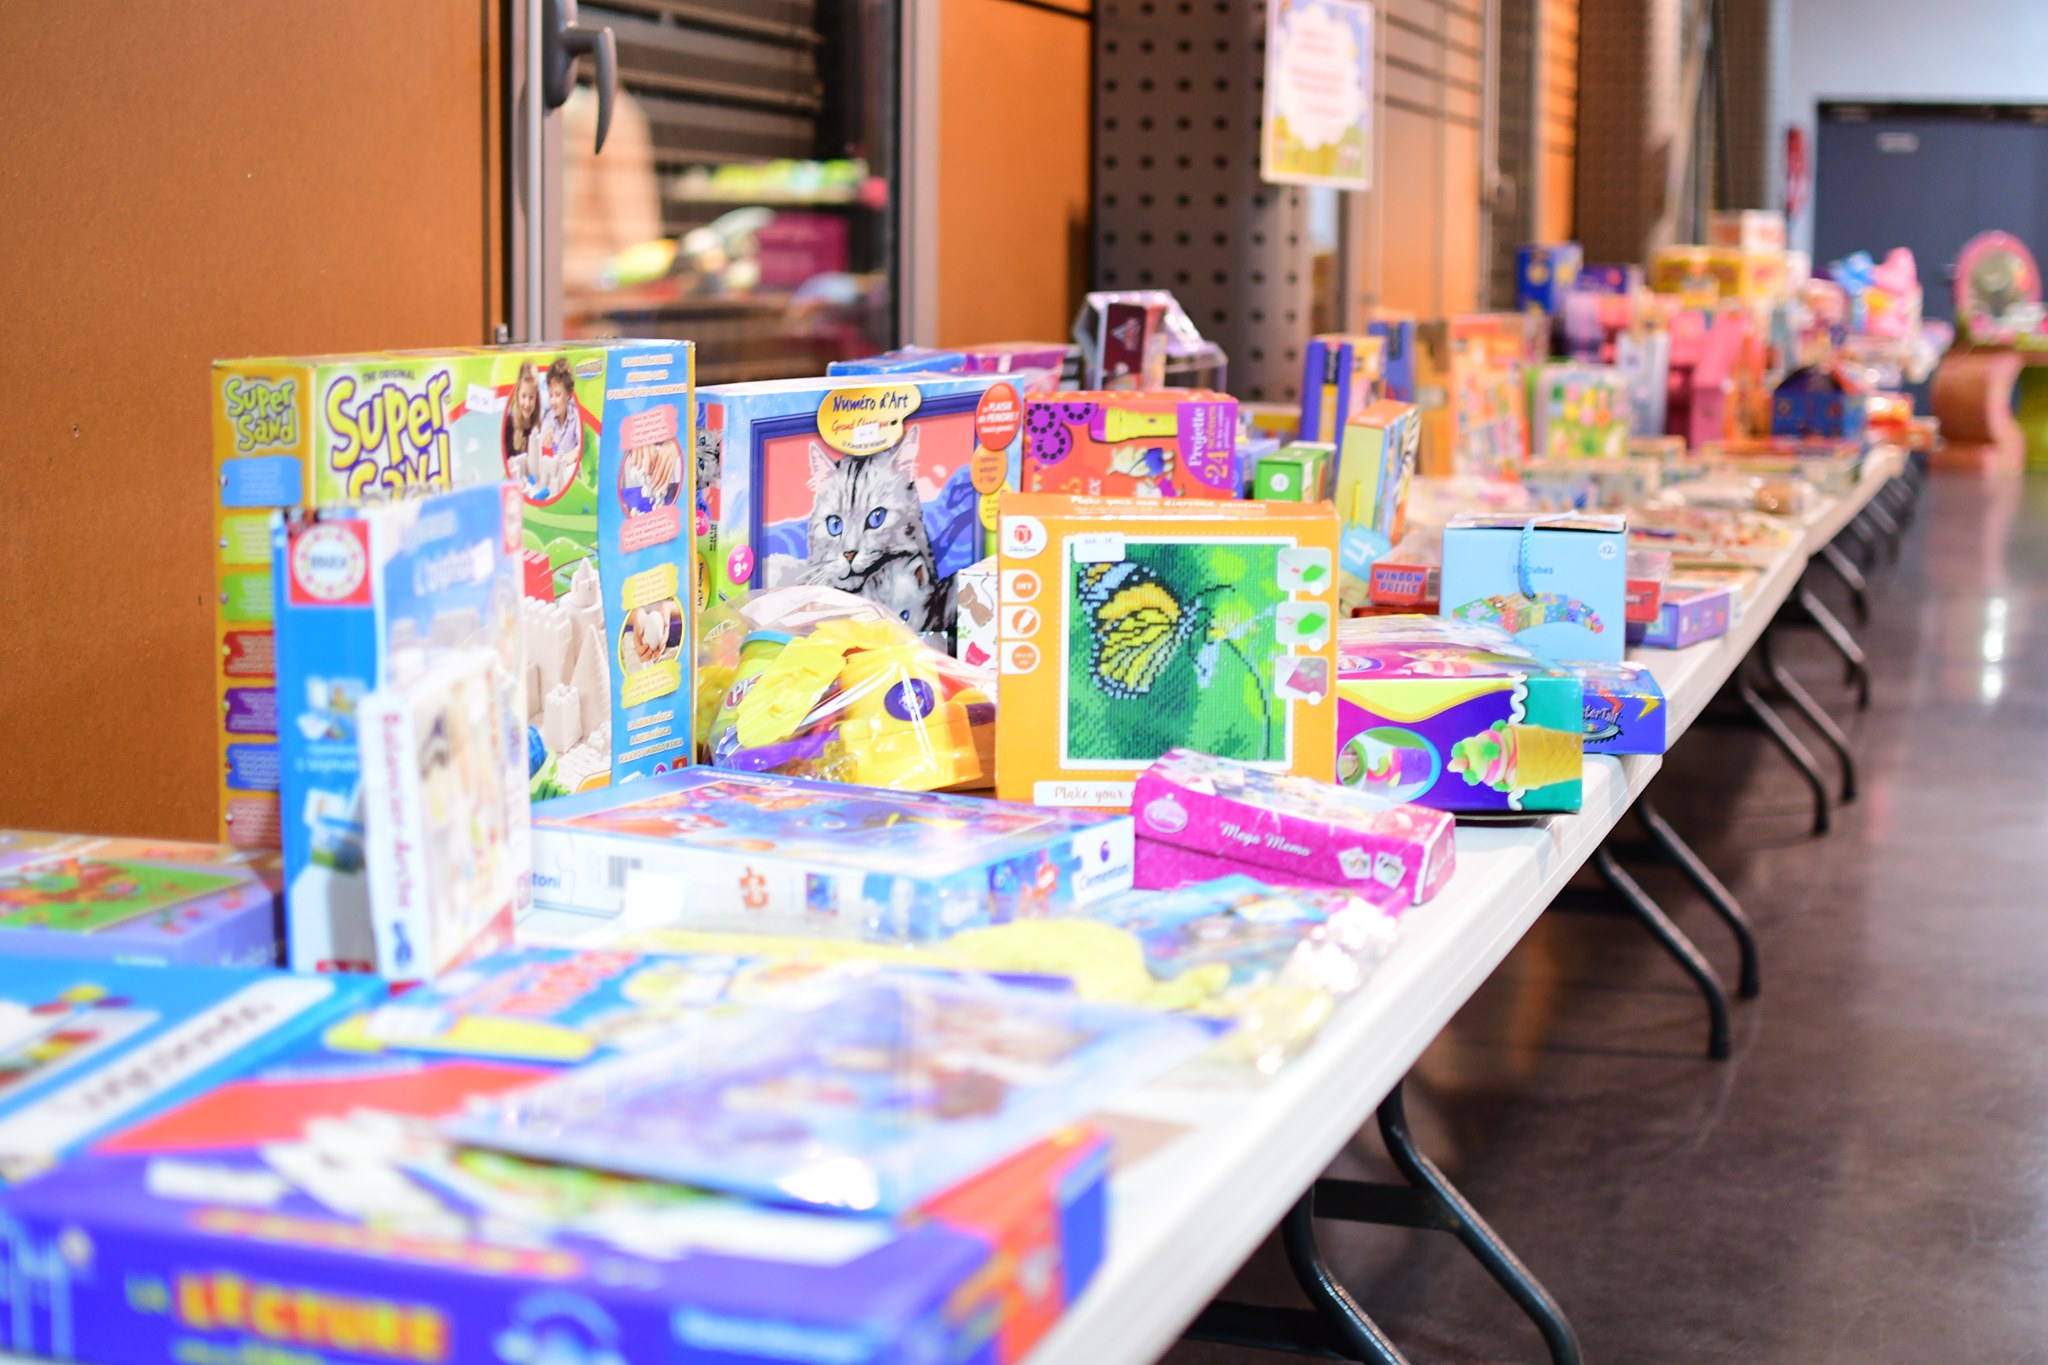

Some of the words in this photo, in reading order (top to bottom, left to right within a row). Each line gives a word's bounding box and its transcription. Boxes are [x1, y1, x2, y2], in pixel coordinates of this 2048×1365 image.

[378, 368, 415, 381] ORIGINAL
[225, 378, 295, 418] Super
[832, 394, 876, 412] Numéro
[879, 390, 909, 409] d'Art
[324, 369, 451, 473] Super
[1188, 406, 1208, 467] Projette
[1204, 450, 1229, 479] 24
[733, 561, 749, 578] 9+
[1375, 570, 1425, 583] WINDOW
[1379, 582, 1419, 596] PUZZLE
[1054, 786, 1088, 799] Make
[1095, 789, 1124, 802] your
[530, 871, 562, 889] toni
